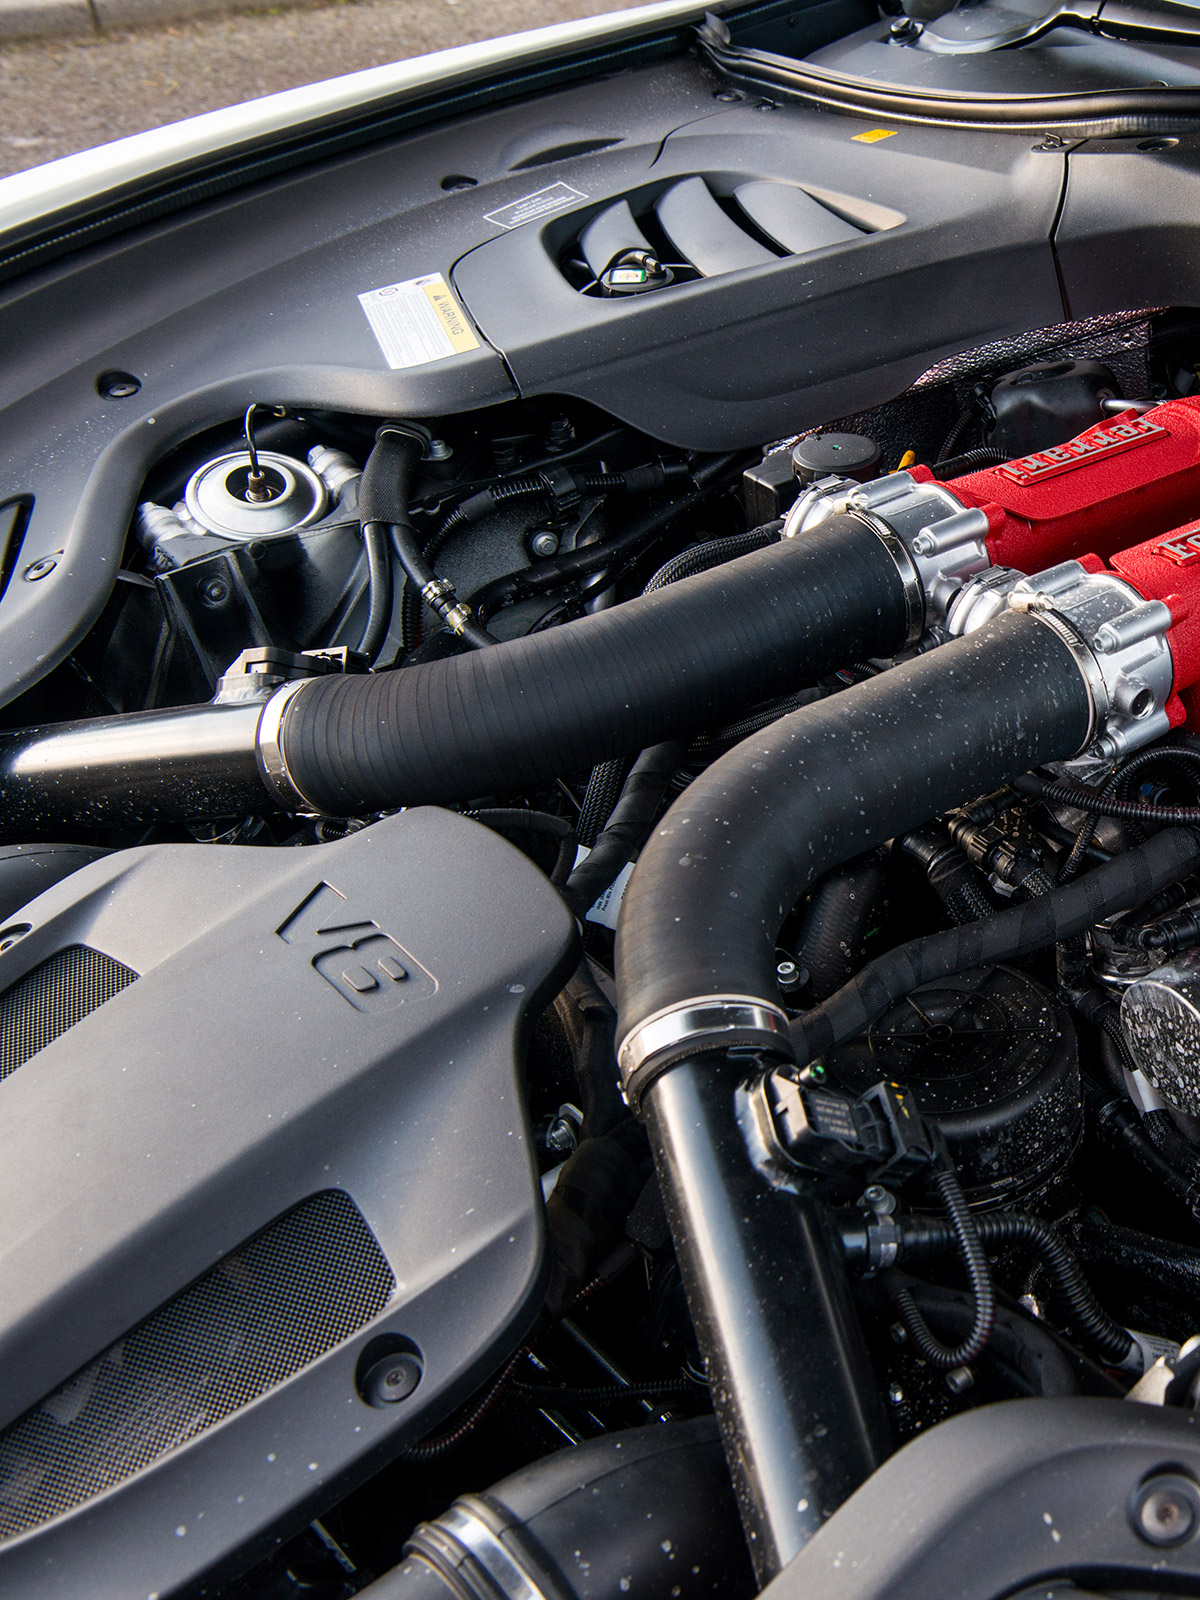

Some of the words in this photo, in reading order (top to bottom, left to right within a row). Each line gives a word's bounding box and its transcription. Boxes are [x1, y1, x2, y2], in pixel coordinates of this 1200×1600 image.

[437, 300, 464, 335] WARNING
[999, 418, 1167, 480] Ferrari
[274, 879, 440, 1015] V8
